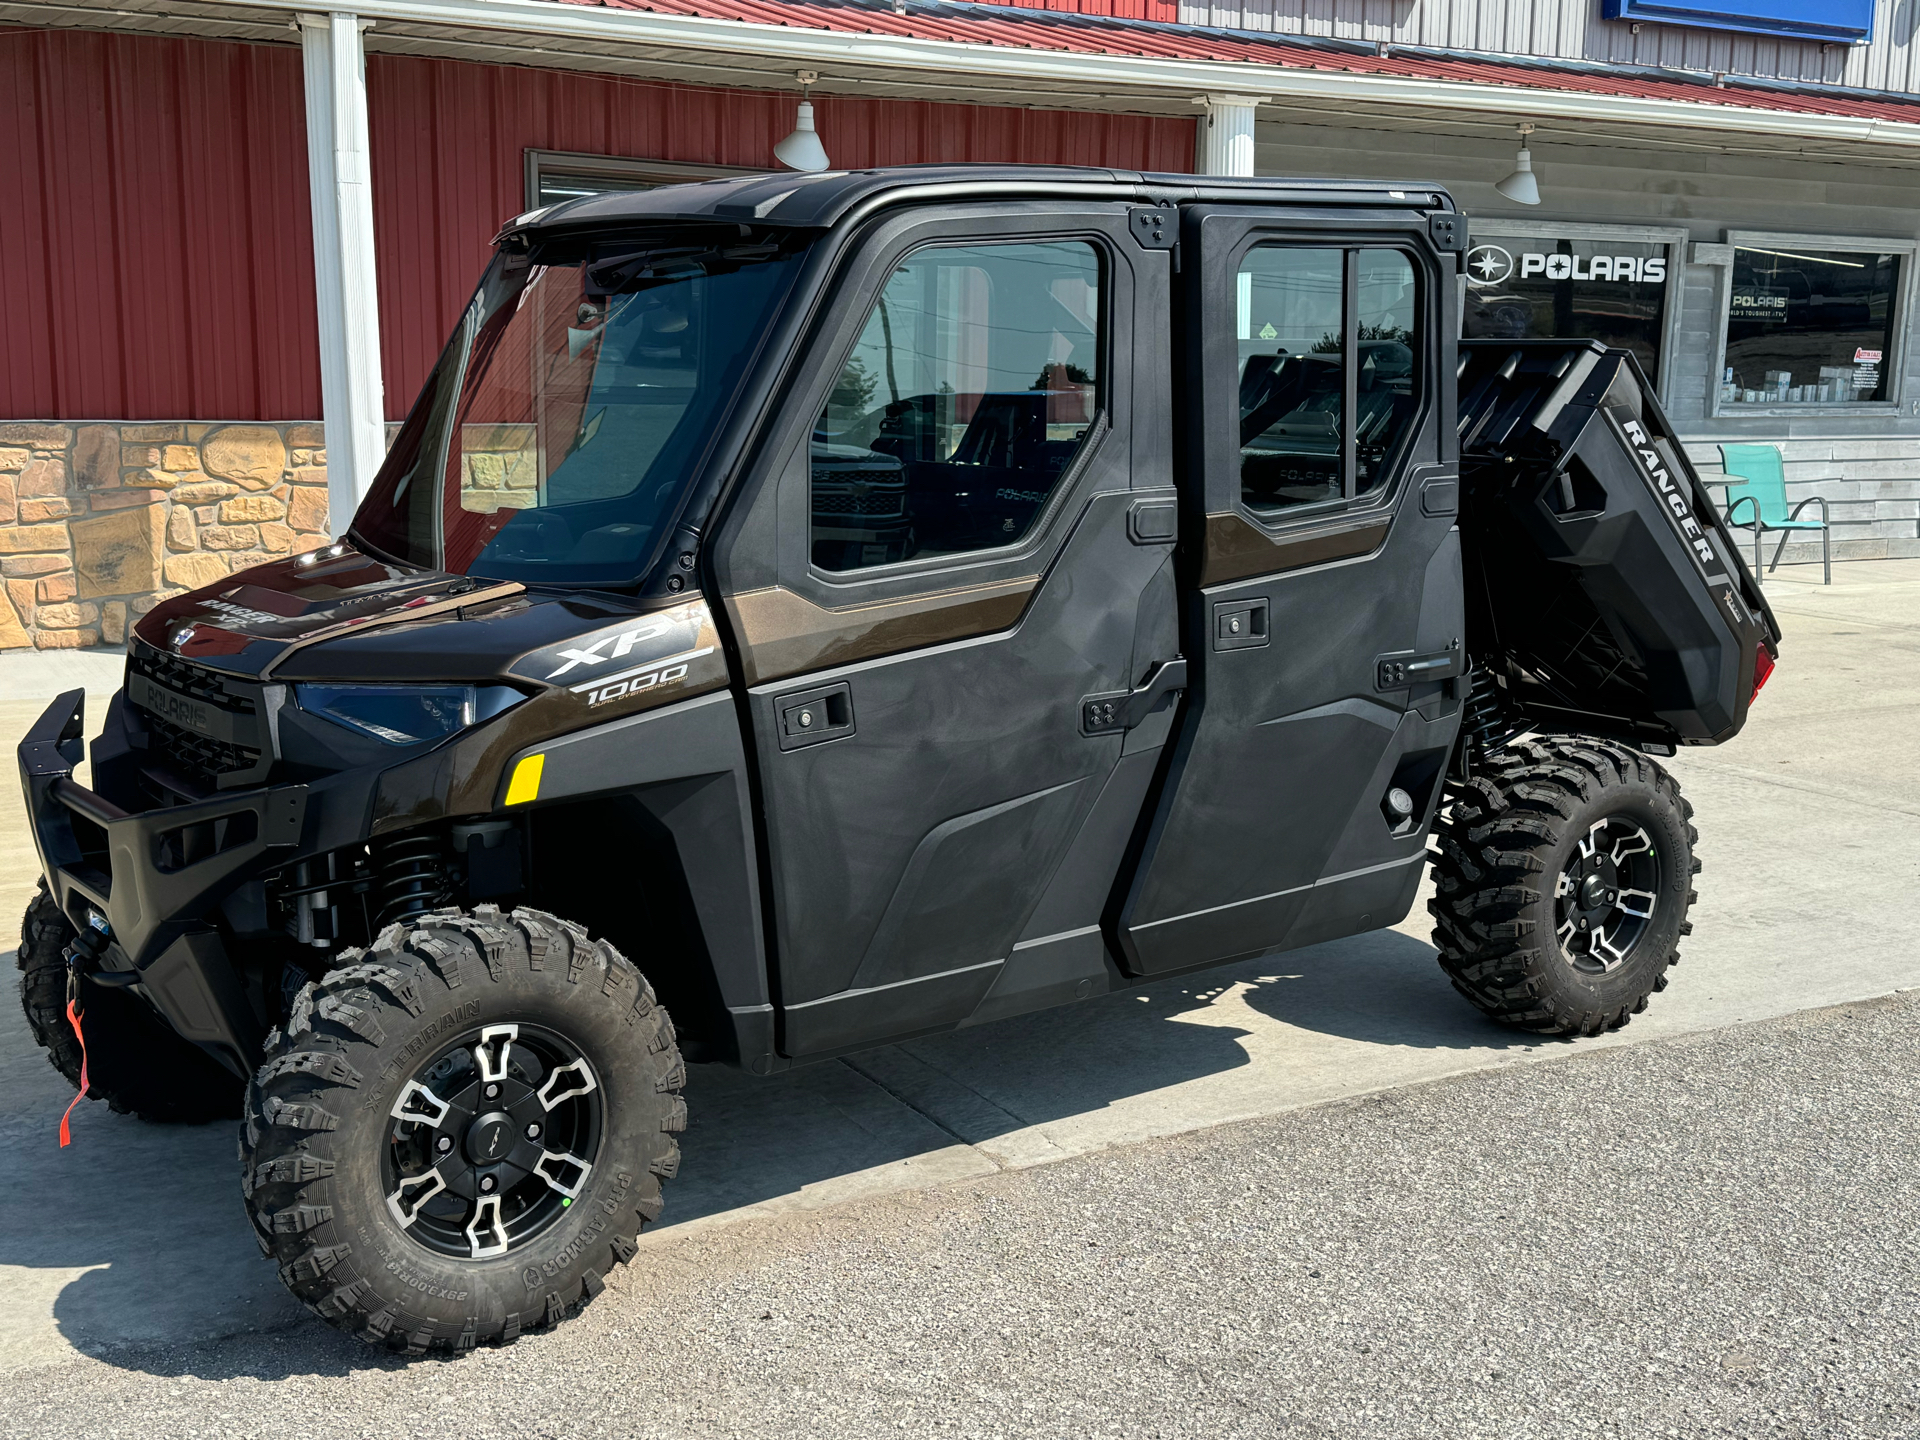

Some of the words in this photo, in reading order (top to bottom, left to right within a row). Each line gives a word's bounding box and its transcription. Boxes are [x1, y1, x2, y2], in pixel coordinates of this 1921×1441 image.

[1521, 253, 1666, 283] POLARIS
[1733, 296, 1786, 307] POLARIS
[1622, 420, 1714, 563] RANGER
[195, 599, 277, 624] RANGER
[209, 613, 248, 625] XP
[545, 614, 676, 680] XP
[588, 663, 689, 706] 1000
[590, 699, 616, 709] DUAL
[618, 682, 667, 701] OVERHEAD
[669, 675, 688, 685] CAM
[147, 684, 207, 729] POLARIS
[363, 998, 481, 1113] X-TERRAIN
[603, 1173, 632, 1215] PRO
[541, 1214, 607, 1277] ARMOR
